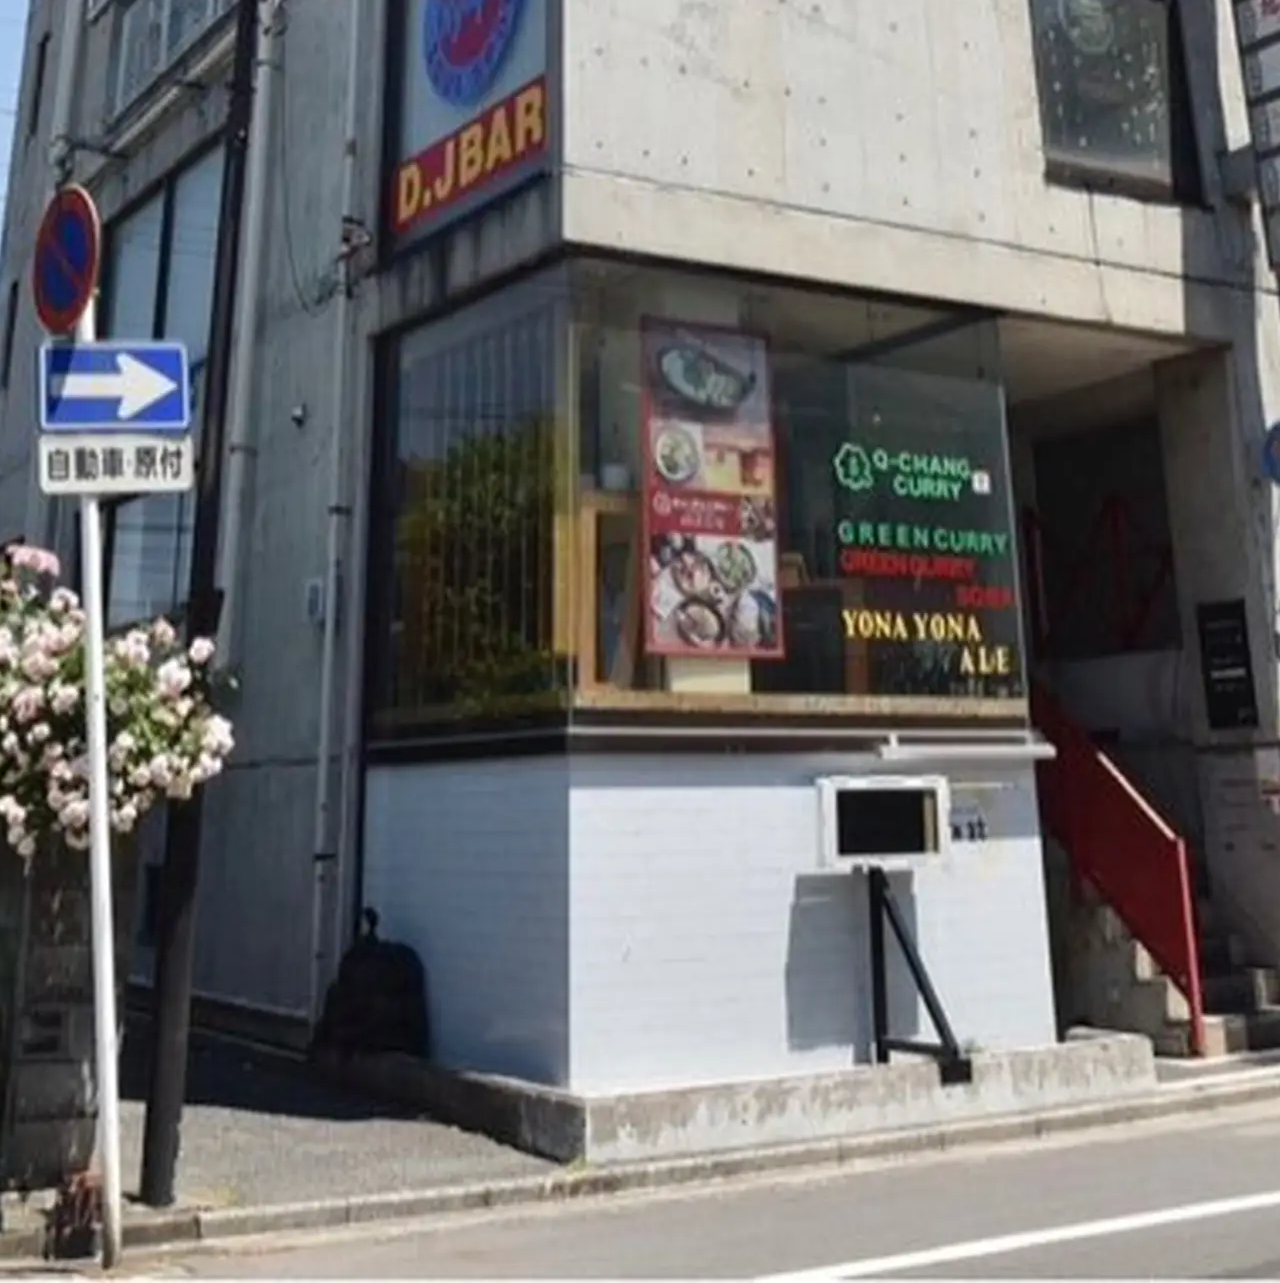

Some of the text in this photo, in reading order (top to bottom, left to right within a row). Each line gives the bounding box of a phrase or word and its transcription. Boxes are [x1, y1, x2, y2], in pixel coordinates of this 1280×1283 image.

[892, 475, 963, 502] CURRY
[837, 520, 1009, 554] GREEN CURRY
[841, 608, 983, 643] YONA YONA
[960, 645, 1011, 674] ALE
